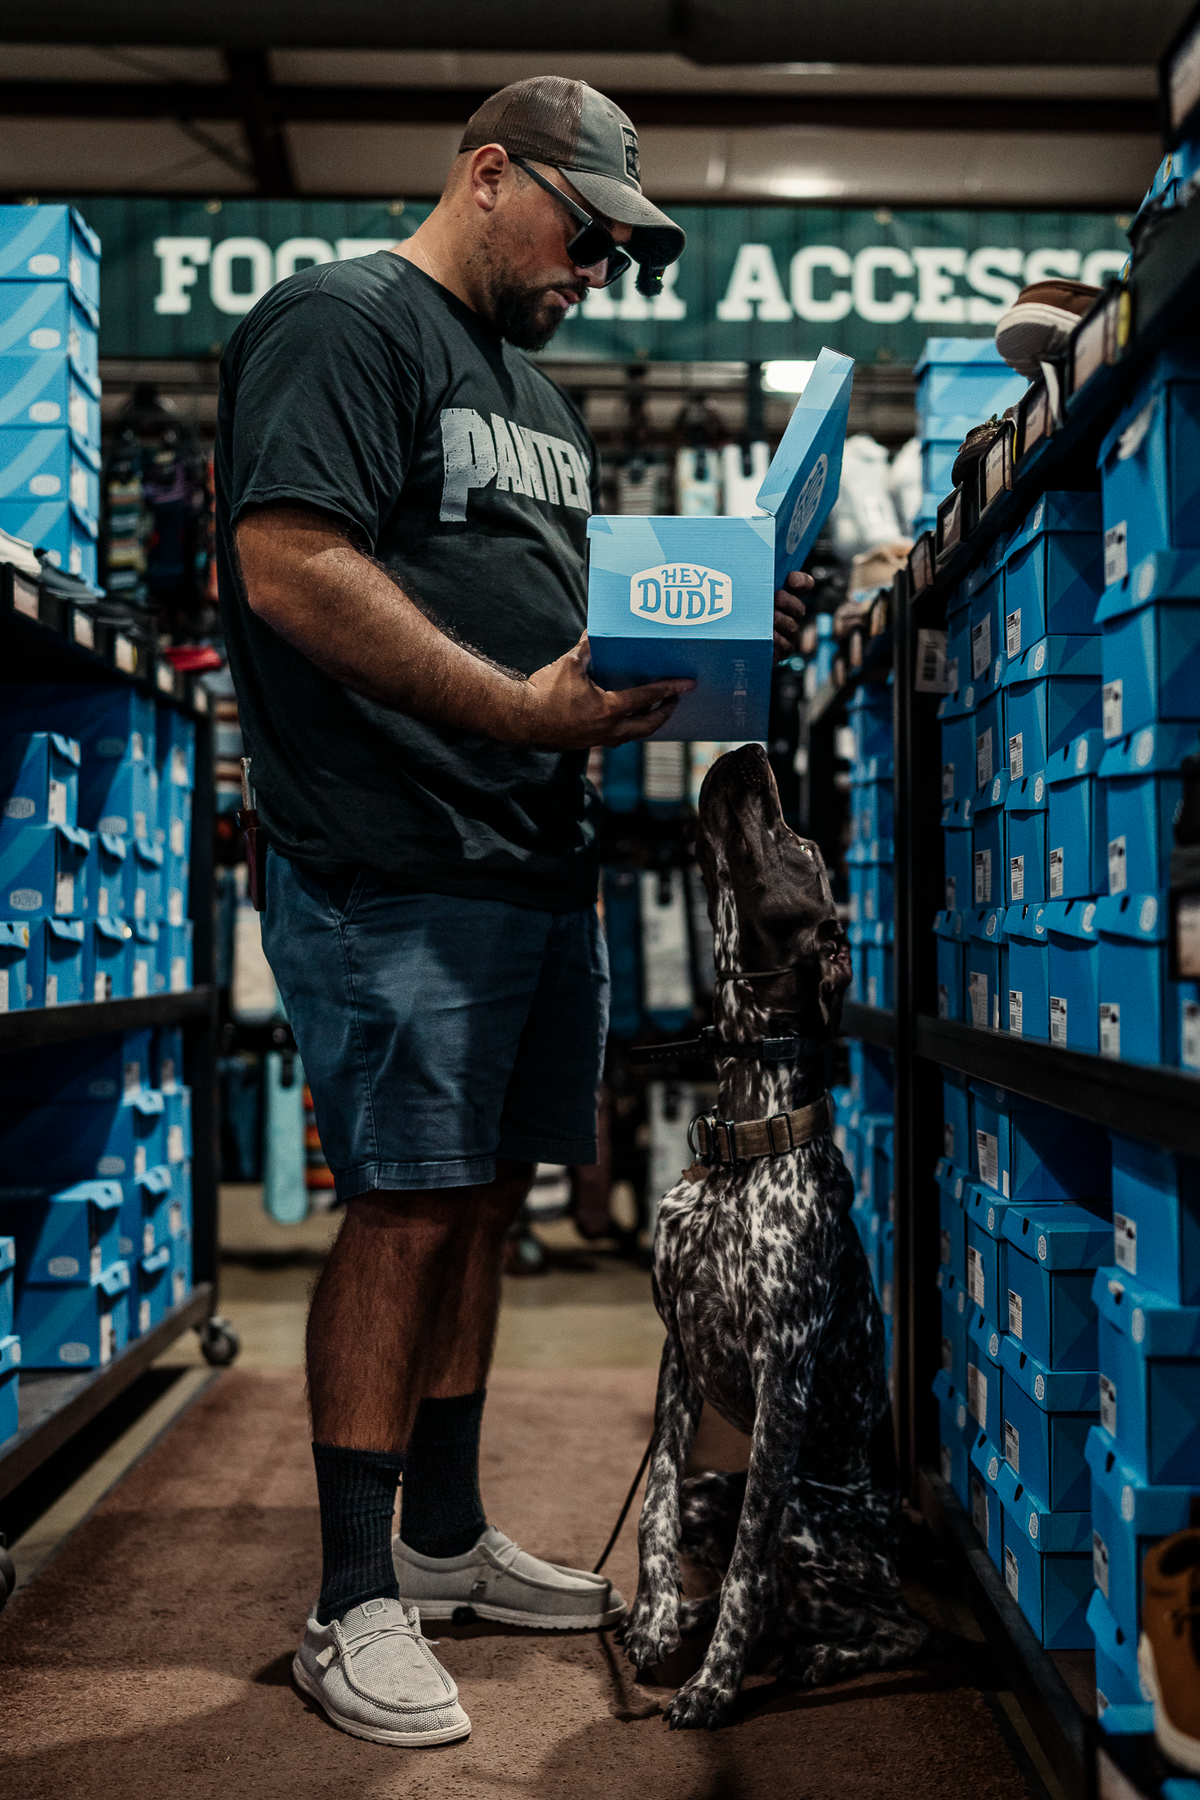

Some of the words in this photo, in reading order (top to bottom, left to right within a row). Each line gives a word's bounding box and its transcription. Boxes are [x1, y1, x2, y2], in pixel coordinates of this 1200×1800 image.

[440, 408, 592, 522] PANTER
[637, 578, 724, 619] DUDE
[661, 568, 708, 588] HEY
